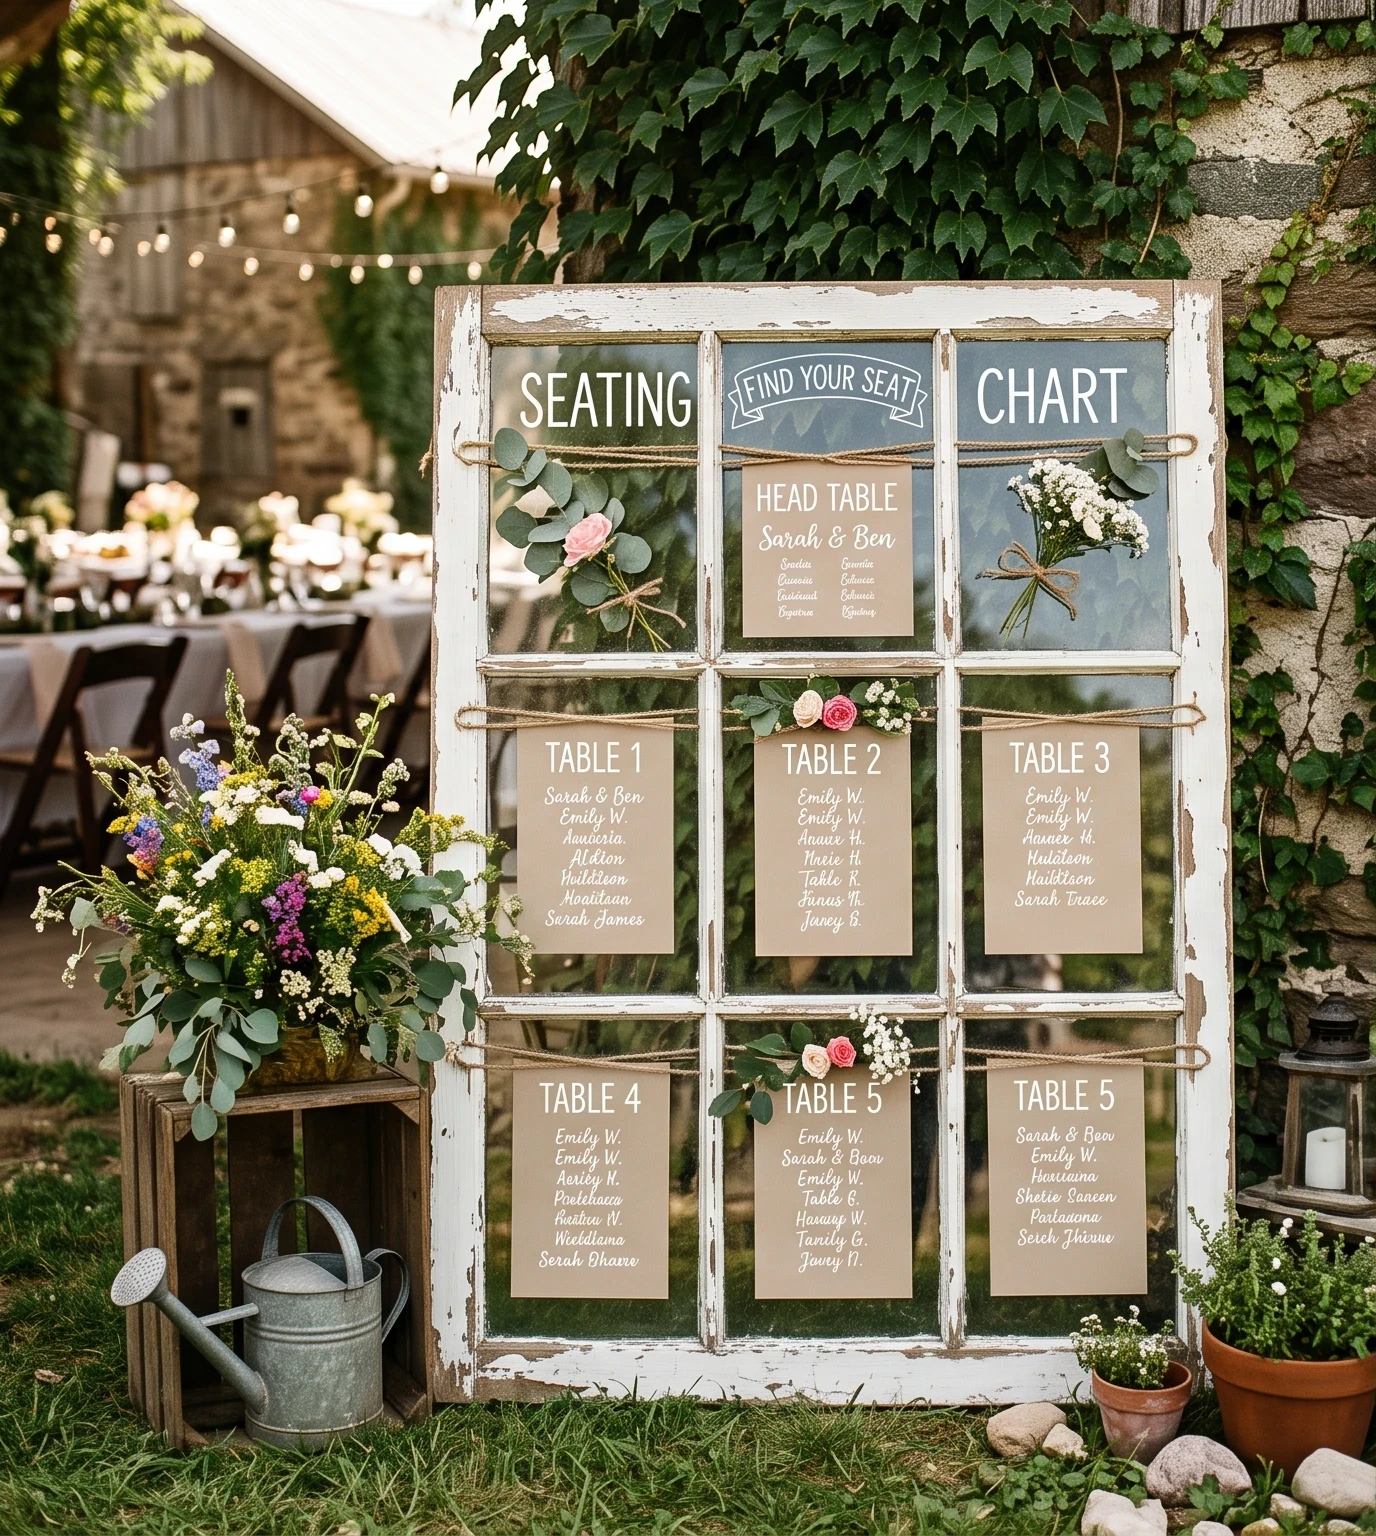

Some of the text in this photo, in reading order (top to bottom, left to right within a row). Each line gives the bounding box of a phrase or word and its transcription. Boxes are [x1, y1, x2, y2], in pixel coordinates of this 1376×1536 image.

[742, 366, 918, 405] FIND YOUR SEAT
[977, 366, 1128, 425] CHART
[519, 370, 693, 429] SEATING
[757, 483, 898, 511] HEAD TABLE
[759, 524, 896, 551] Sarah & Ben
[545, 742, 640, 773] TABLE 1
[782, 743, 881, 775] TABLE 2
[1010, 742, 1110, 773] TABLE 3
[545, 786, 644, 806] Sarah & Ben
[798, 787, 842, 812] Emily
[1026, 786, 1093, 812] Emily W.
[560, 807, 628, 832] Emily W.
[798, 808, 865, 832] Emily W.
[1026, 807, 1093, 831] Emily W.
[1015, 889, 1061, 907] Sarah
[594, 909, 645, 929] James
[539, 1083, 641, 1113] TABLE 4
[783, 1083, 882, 1114] TABLE 5
[1014, 1079, 1114, 1111] TABLE 5
[555, 1127, 621, 1150] Emily W.
[798, 1127, 863, 1150] Emily W.
[1016, 1126, 1061, 1143] Sarah
[1065, 1127, 1078, 1142] &
[555, 1148, 622, 1172] Emily W.
[782, 1149, 827, 1166] Sarah
[831, 1150, 844, 1164] &
[1031, 1146, 1097, 1170] Emily W.
[798, 1168, 864, 1191] Emily W.
[802, 1190, 842, 1206] Table
[851, 1210, 867, 1225] W.
[851, 1231, 868, 1246] G.
